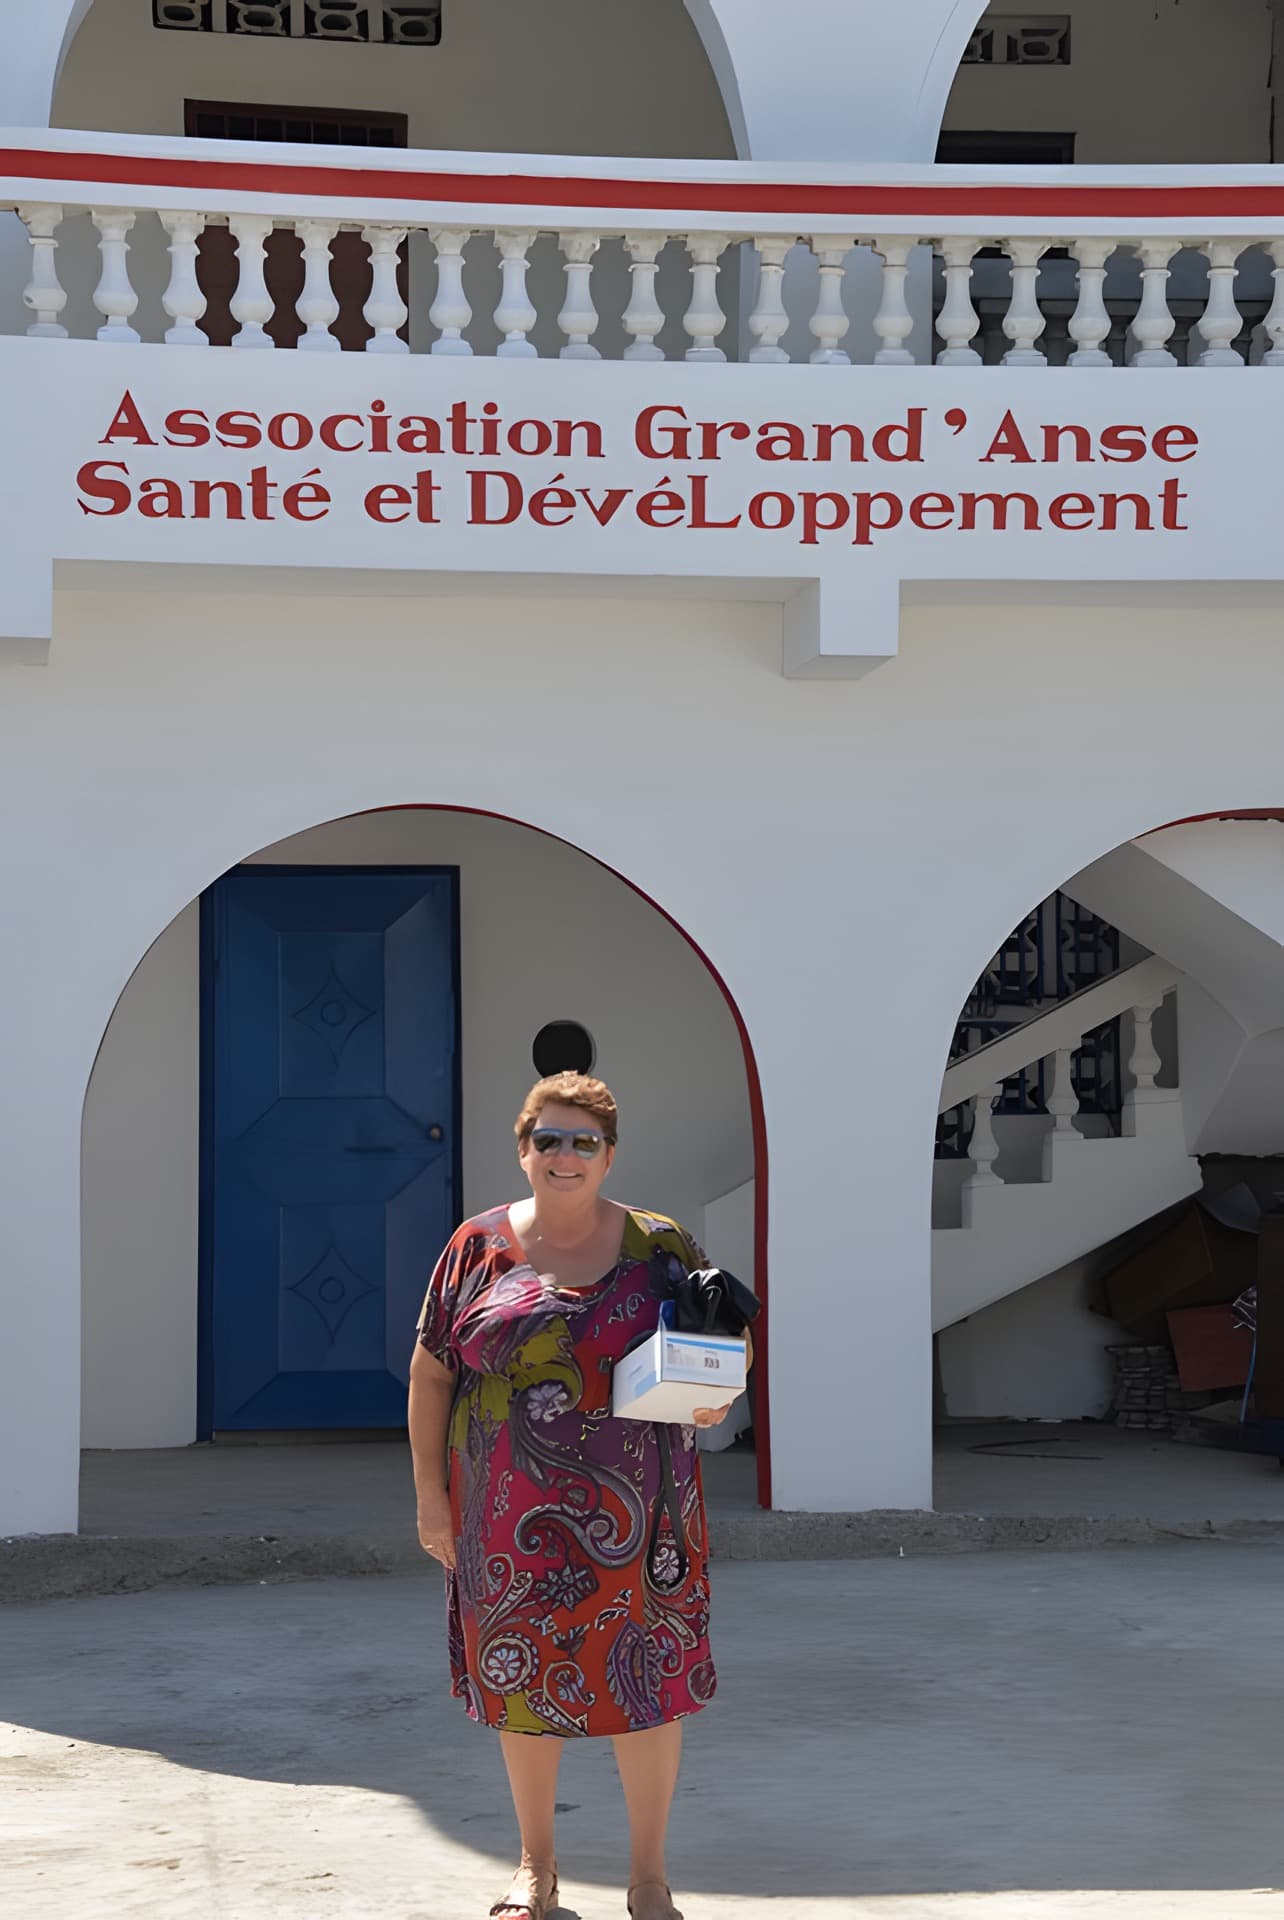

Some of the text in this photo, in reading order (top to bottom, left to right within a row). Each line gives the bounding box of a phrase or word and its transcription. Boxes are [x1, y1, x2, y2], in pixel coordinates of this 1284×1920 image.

[100, 390, 603, 458] Association
[76, 460, 1188, 545] Santé et DévéLoppement
